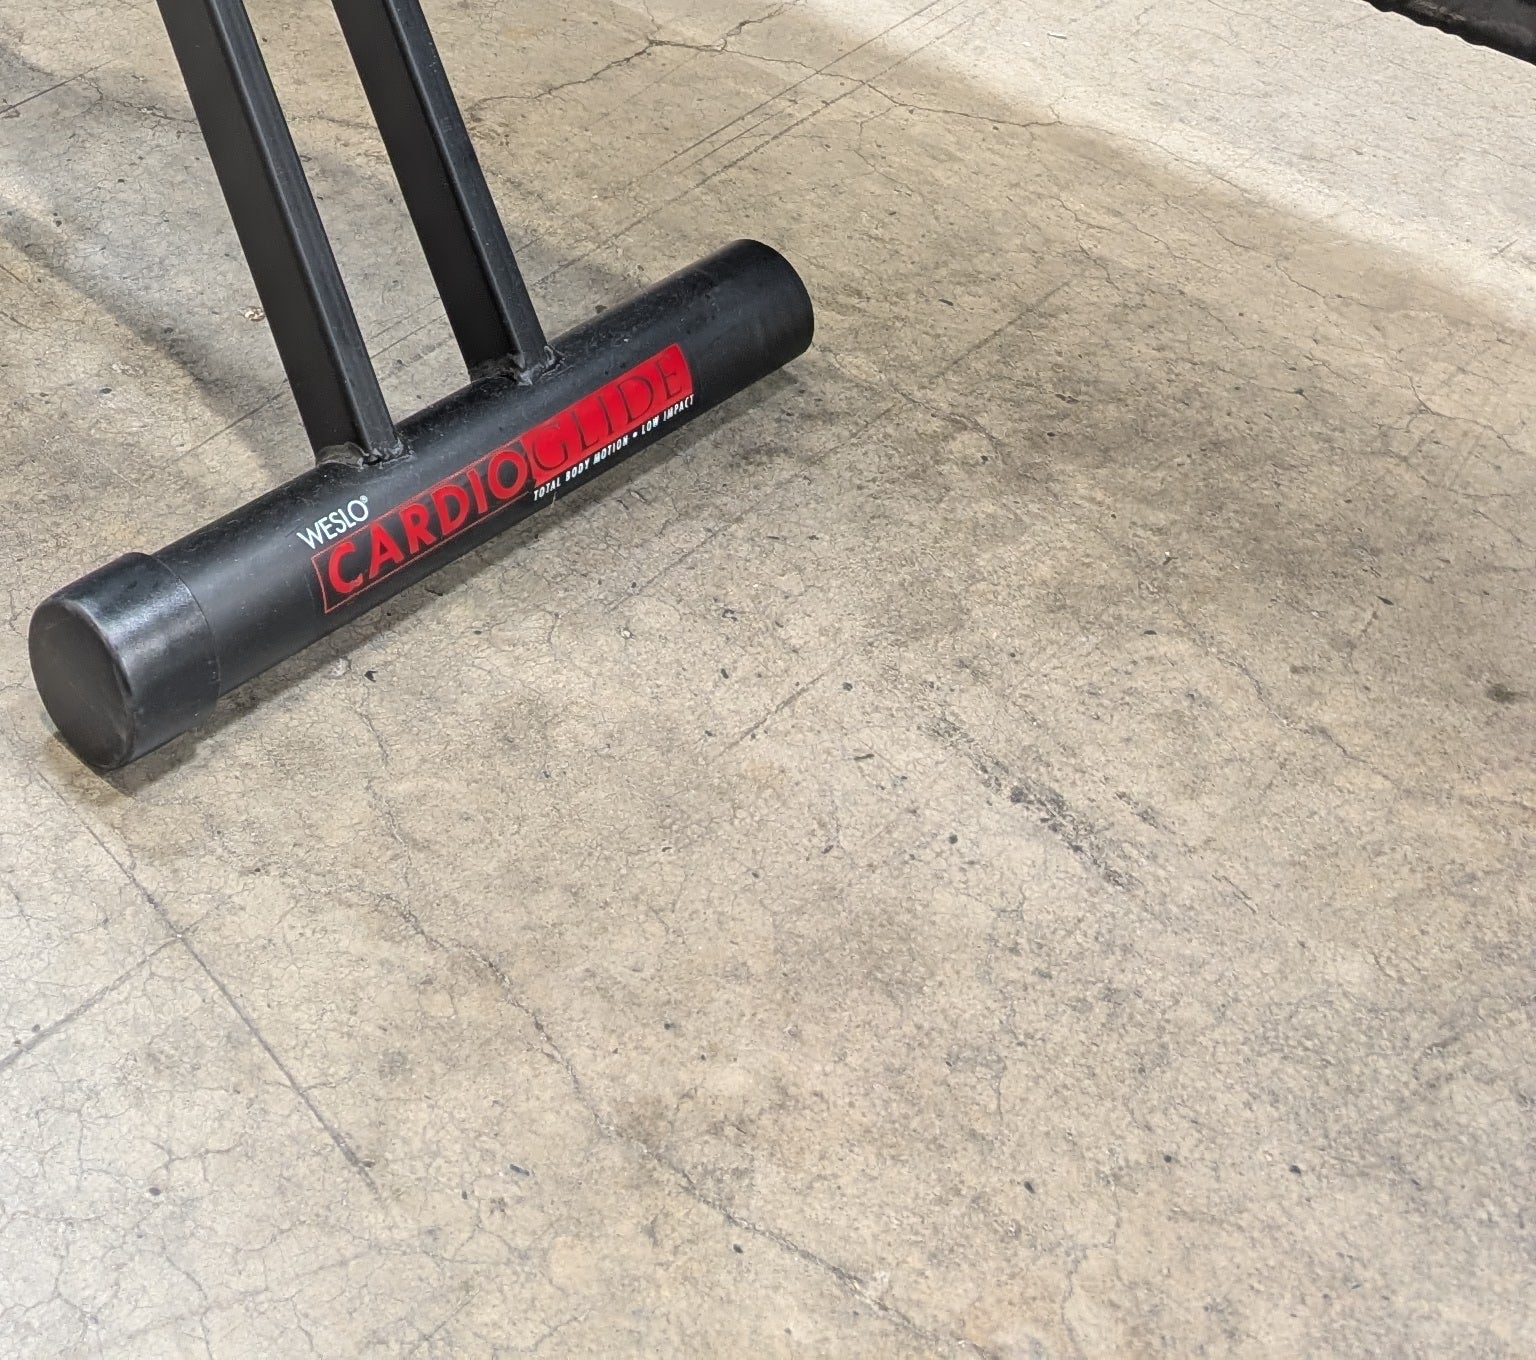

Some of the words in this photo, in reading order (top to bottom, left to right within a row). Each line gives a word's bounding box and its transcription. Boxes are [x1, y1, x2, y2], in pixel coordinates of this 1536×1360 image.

[533, 477, 562, 502] TOTAL
[565, 457, 591, 482] BODY
[593, 434, 630, 466] MOTION
[640, 415, 660, 436] LOW
[663, 393, 696, 423] IMPACT
